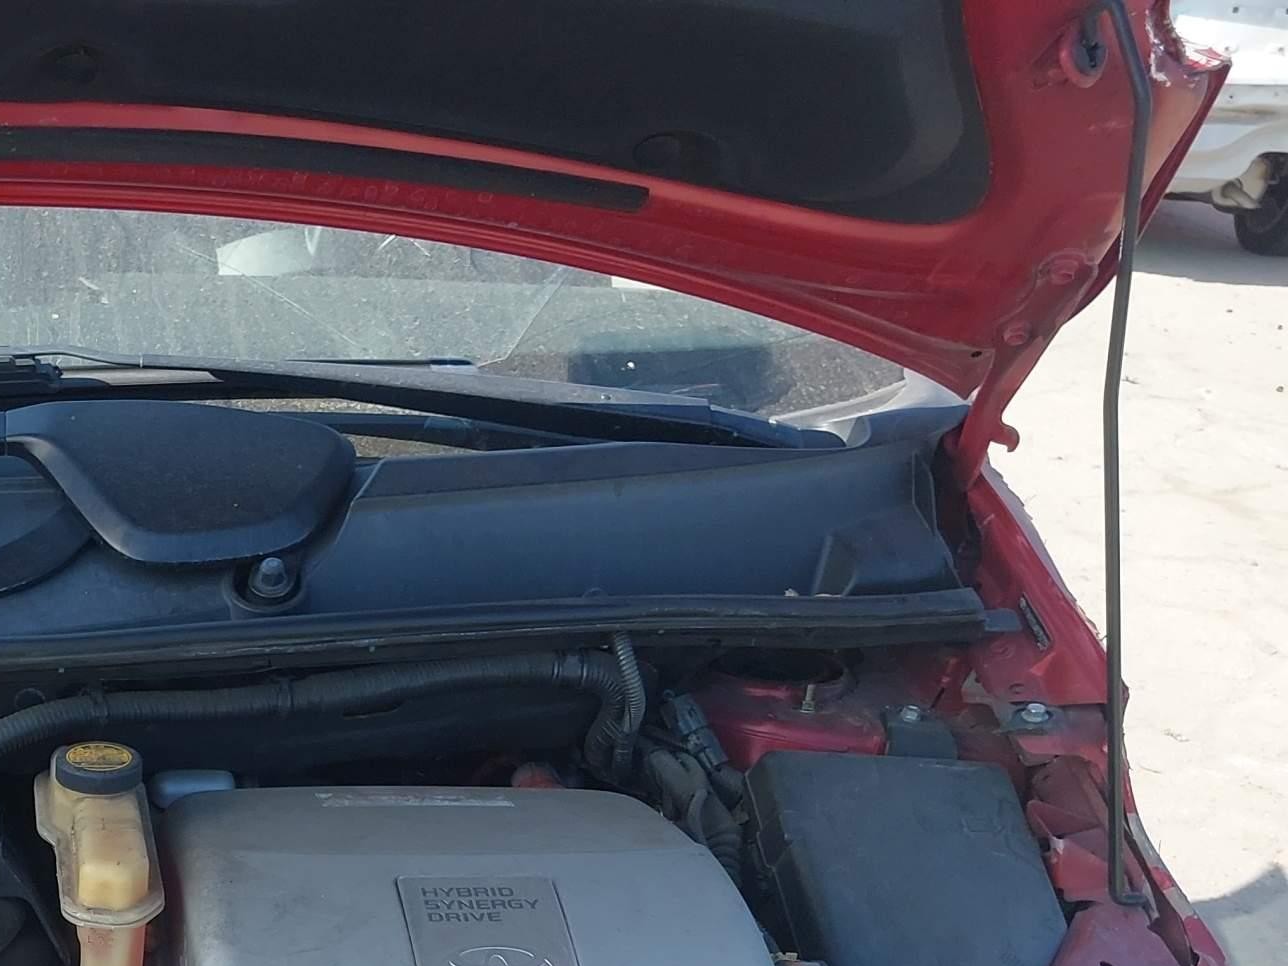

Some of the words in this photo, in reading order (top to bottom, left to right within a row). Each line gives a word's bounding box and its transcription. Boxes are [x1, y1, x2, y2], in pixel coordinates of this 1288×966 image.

[420, 887, 514, 897] HYBRID
[423, 899, 539, 910] SYNERGY
[427, 912, 503, 922] DRIVE
